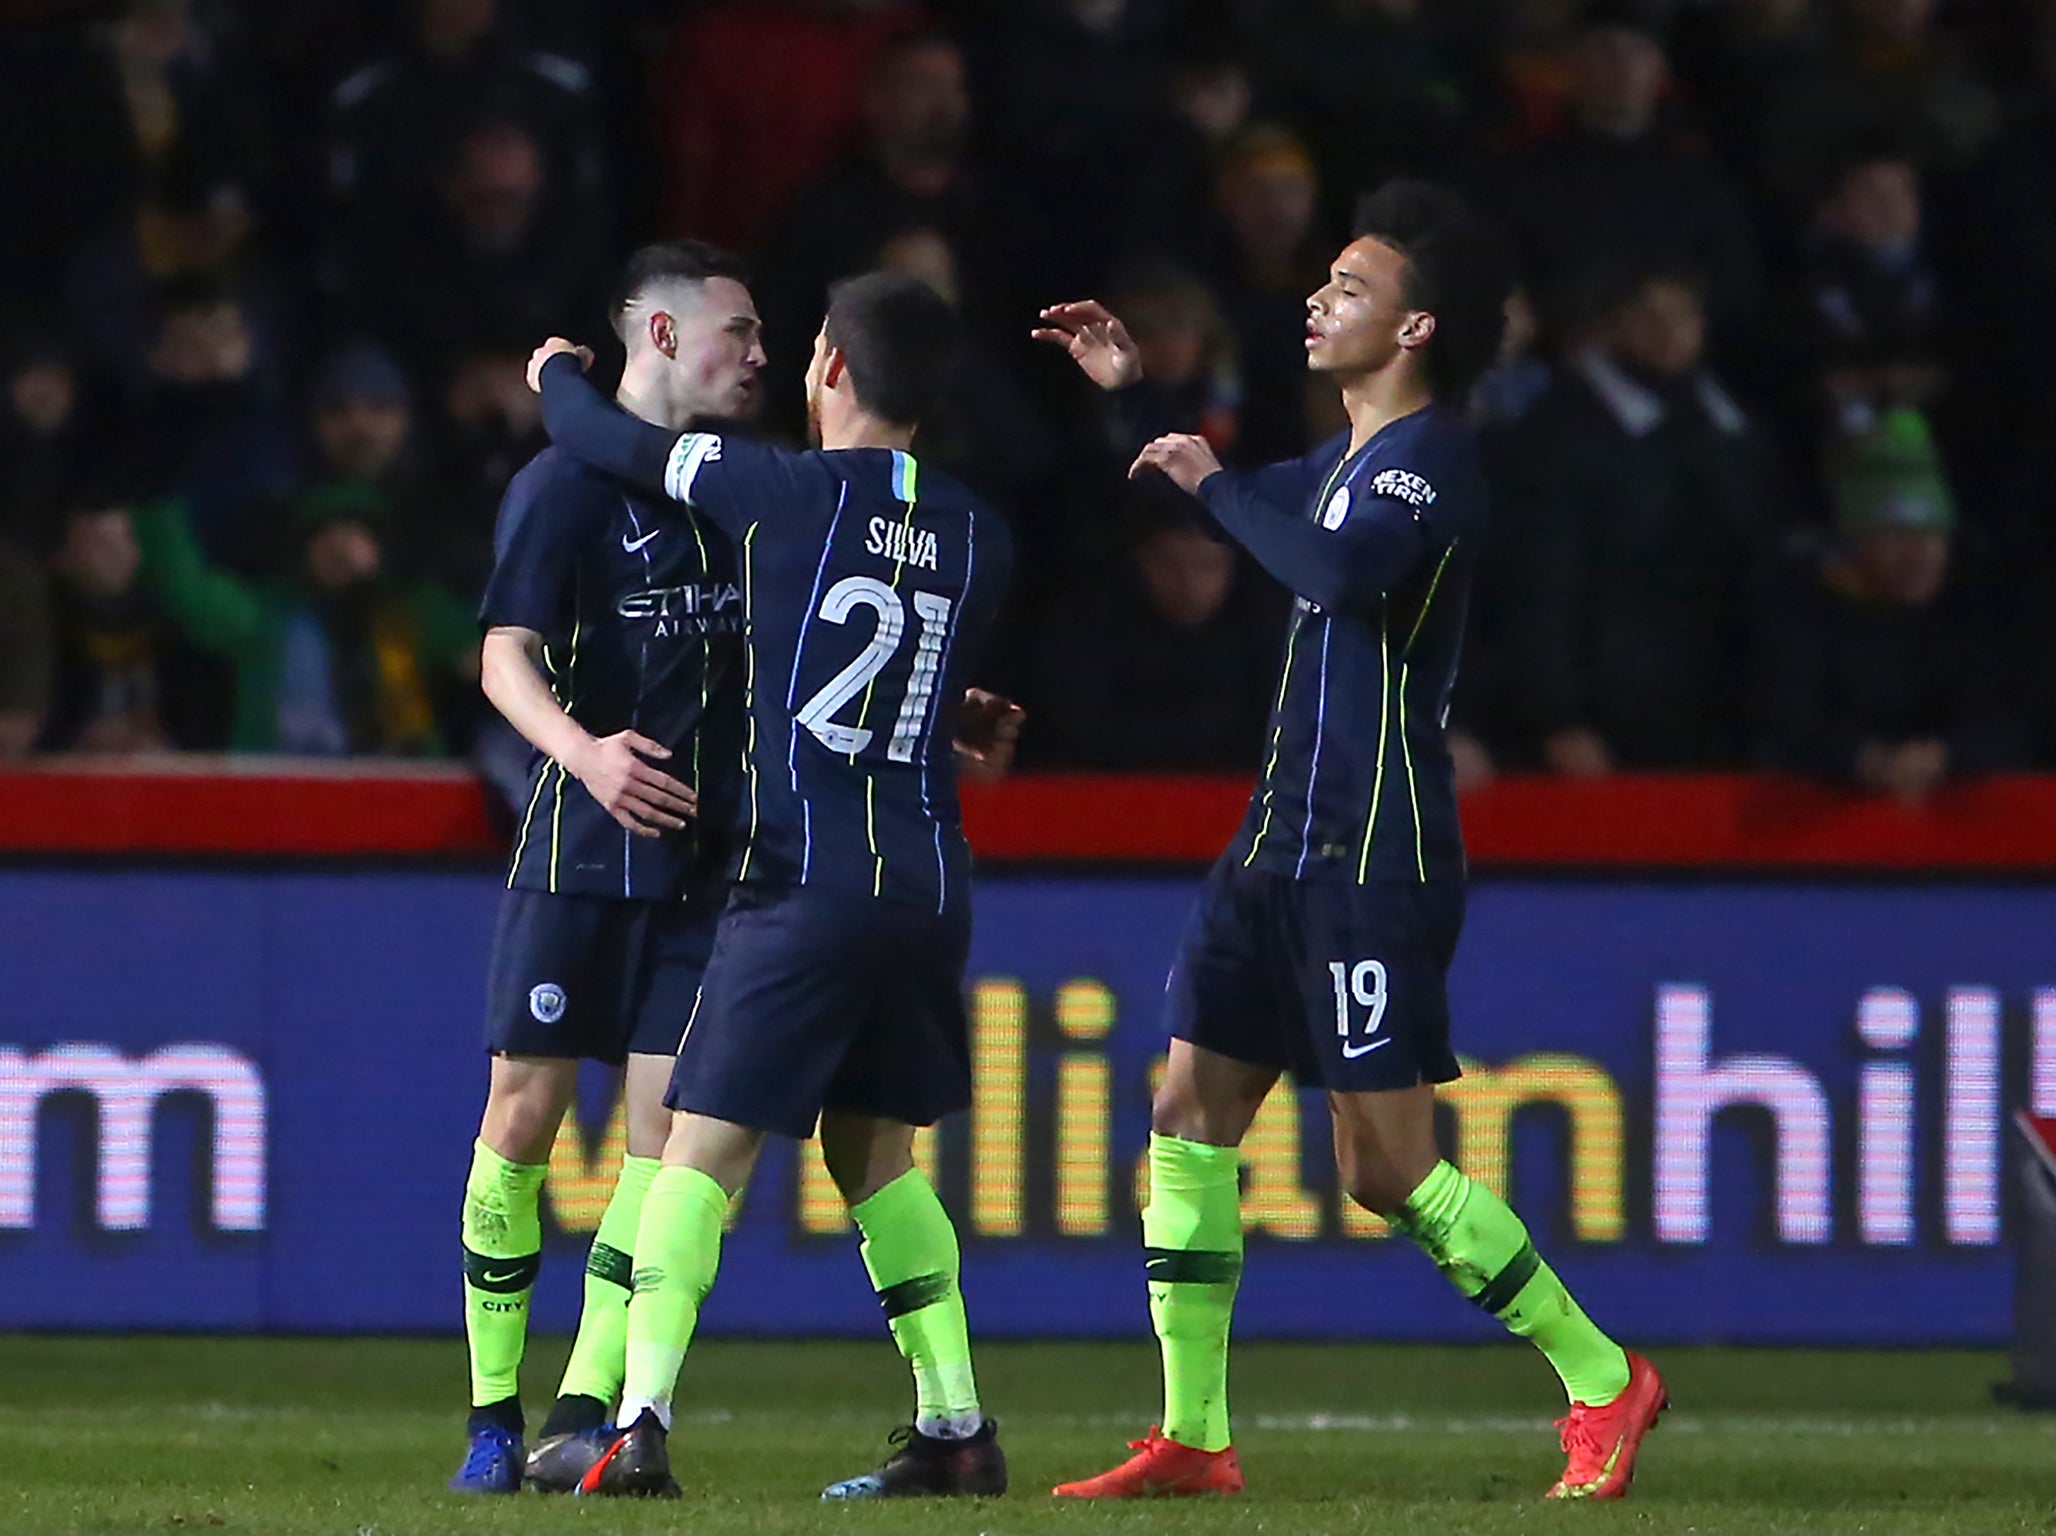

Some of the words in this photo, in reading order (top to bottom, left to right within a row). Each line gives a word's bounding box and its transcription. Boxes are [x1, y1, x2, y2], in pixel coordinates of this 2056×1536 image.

[1373, 469, 1437, 504] NEXEN
[865, 517, 938, 571] SILVA
[617, 583, 741, 617] ETIHA
[795, 576, 951, 762] 21
[1329, 960, 1387, 1035] 19
[482, 1300, 524, 1312] CITY
